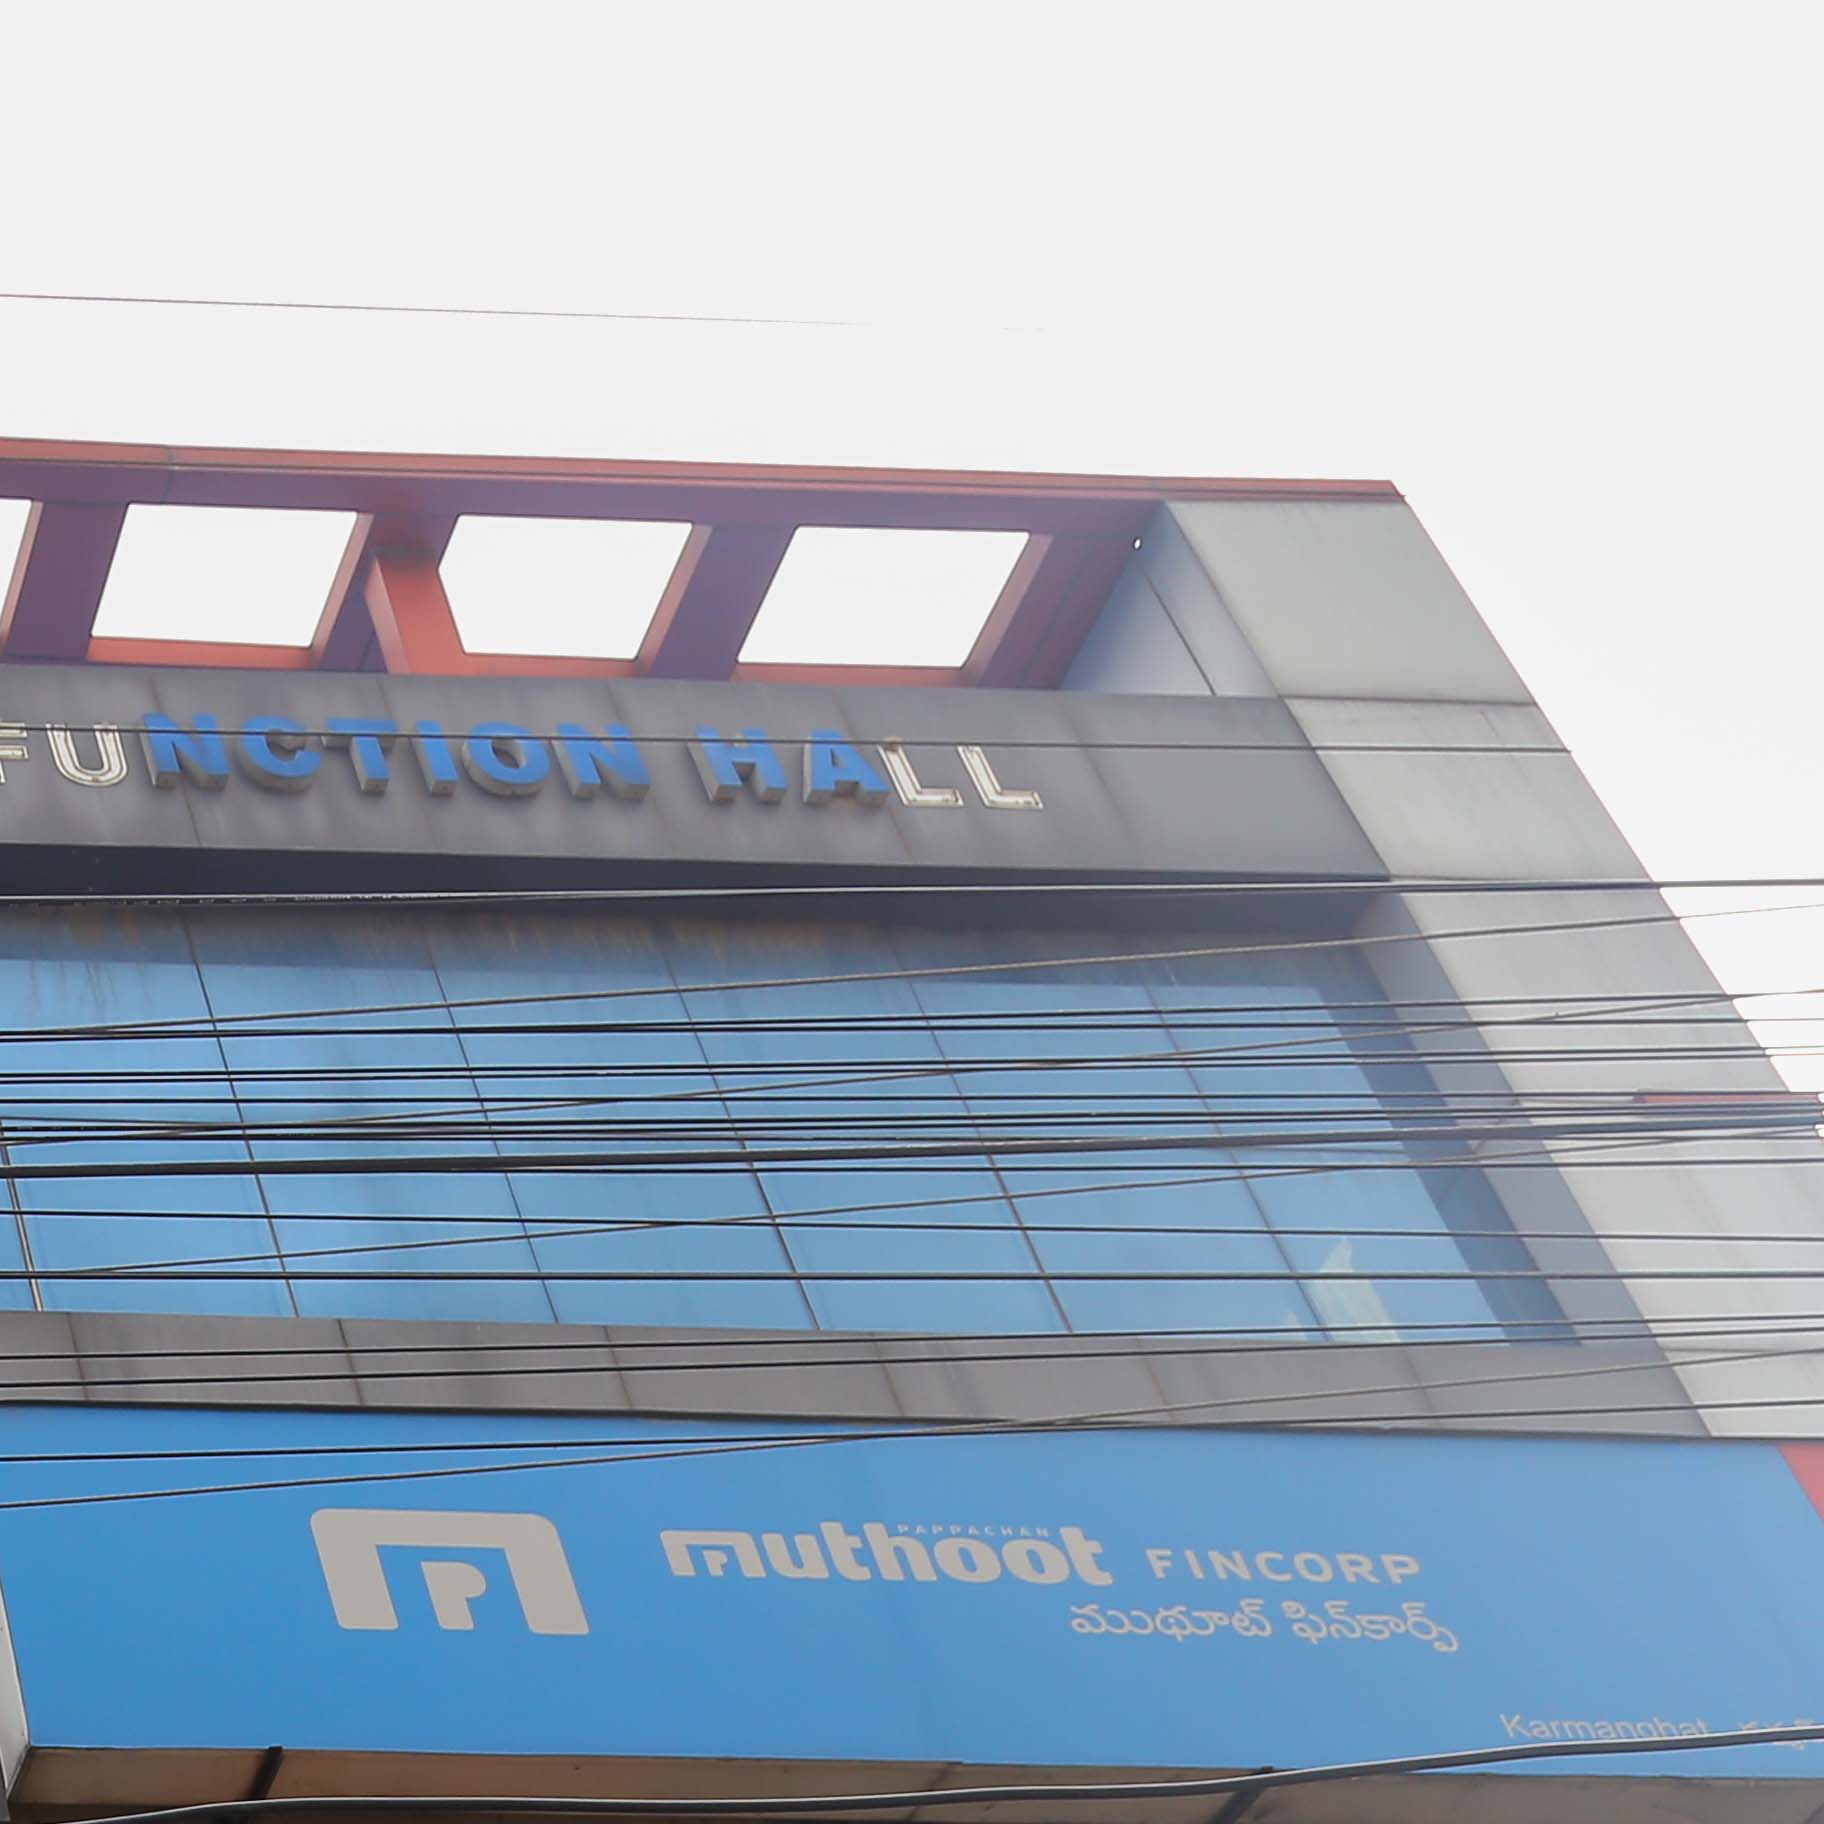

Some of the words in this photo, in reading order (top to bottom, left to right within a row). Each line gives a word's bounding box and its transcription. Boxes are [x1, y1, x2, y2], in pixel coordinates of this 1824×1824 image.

[687, 725, 1045, 811] HALL
[660, 1520, 1113, 1587] muthoot
[1145, 1547, 1422, 1584] FINCORP
